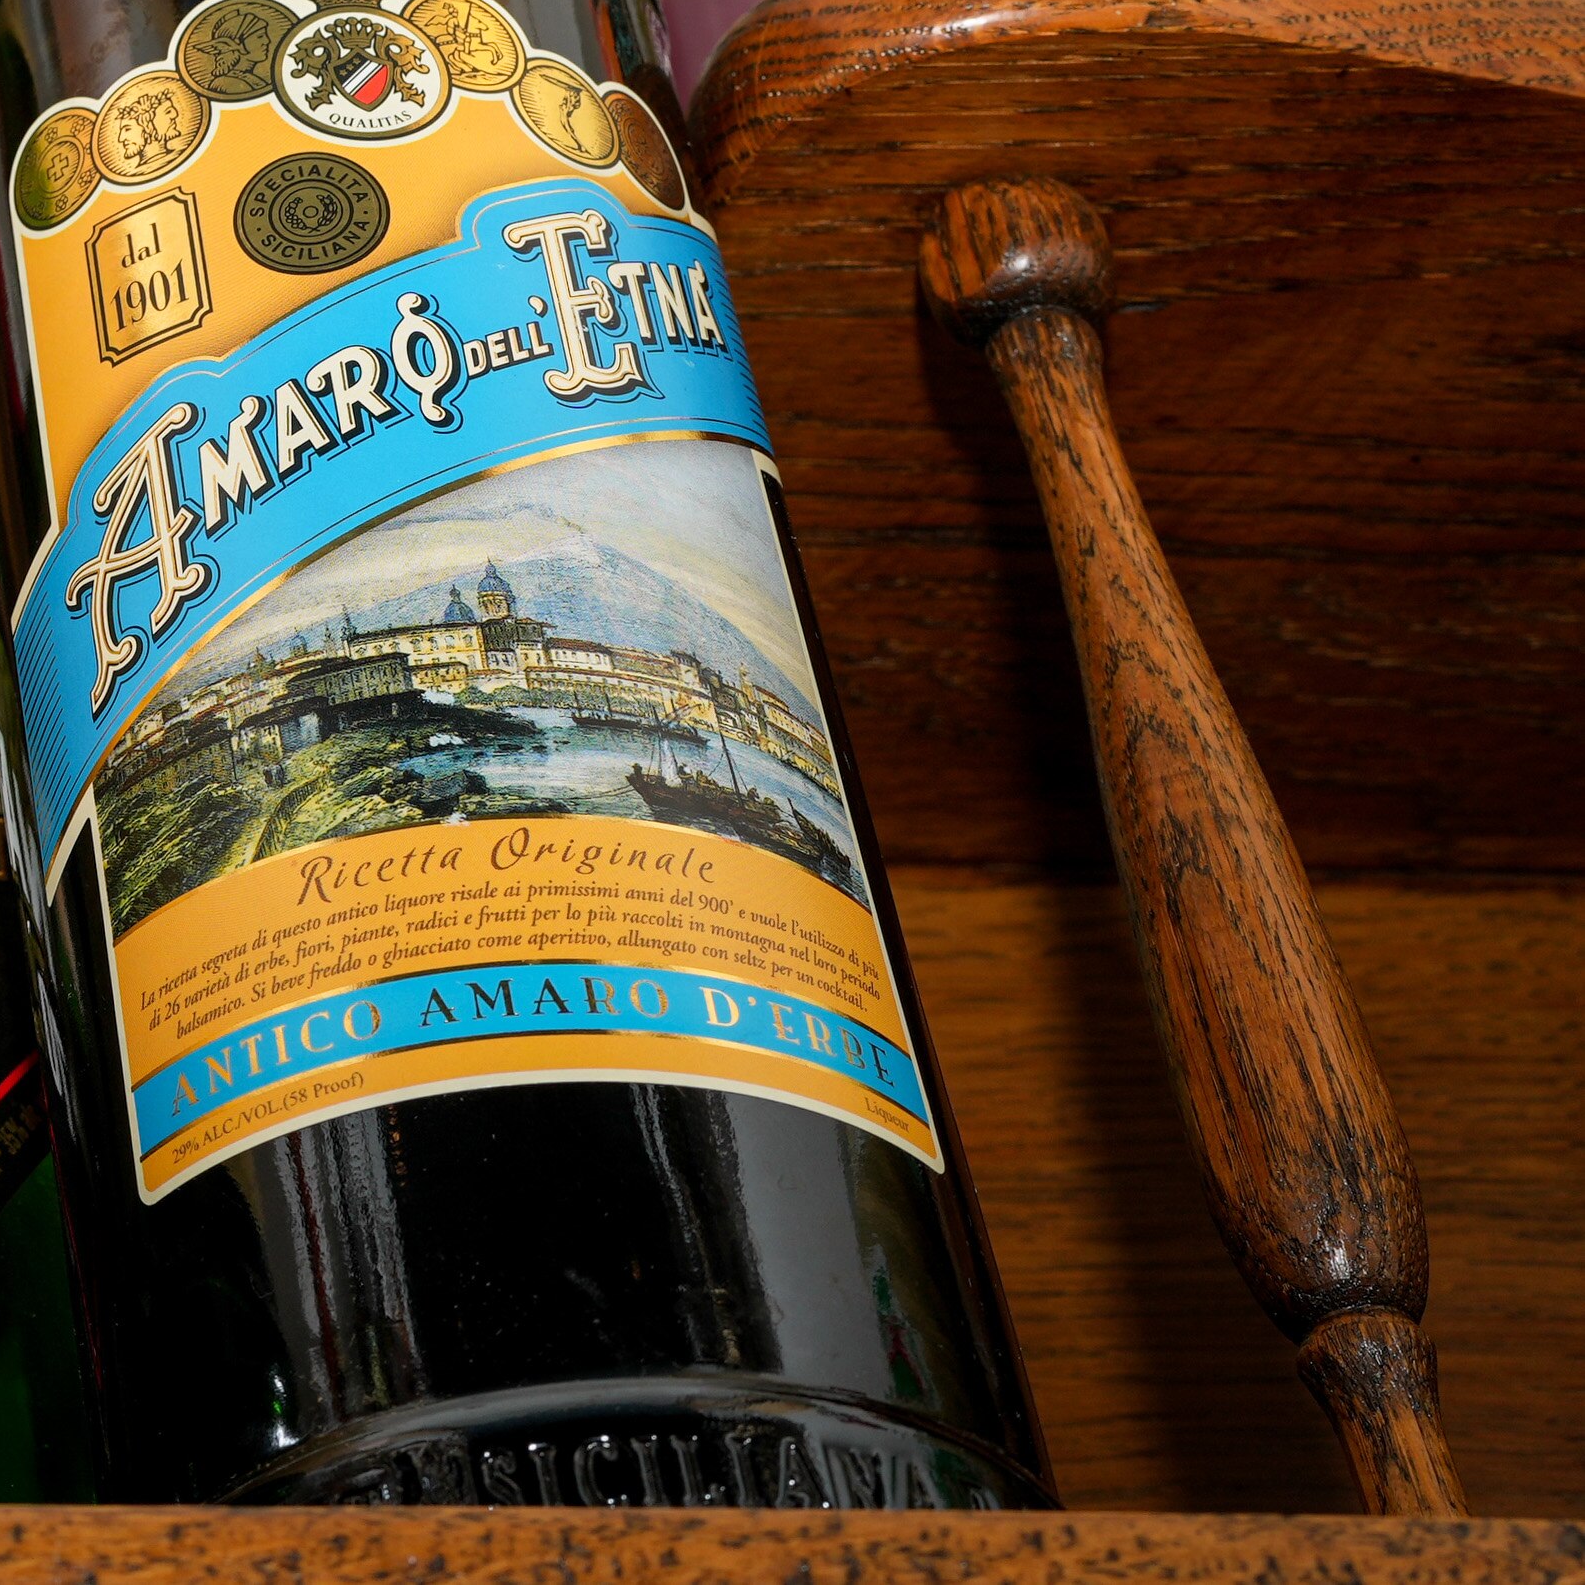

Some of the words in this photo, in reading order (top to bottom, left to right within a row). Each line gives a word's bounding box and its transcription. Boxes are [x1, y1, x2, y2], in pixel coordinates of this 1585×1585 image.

[329, 110, 413, 129] QUALITAS
[121, 222, 163, 269] dal
[261, 219, 370, 261] SICILIANA
[109, 258, 190, 332] 1901
[296, 844, 463, 907] Ricetta
[490, 826, 717, 884] Originale
[140, 991, 156, 1011] La
[156, 965, 198, 1002] ricetta
[200, 942, 248, 982] segreta
[251, 929, 269, 953] di
[271, 915, 322, 950] questo
[325, 900, 380, 927] antico
[383, 889, 446, 918] liquore
[450, 880, 499, 903] risale
[502, 881, 521, 899] ai
[527, 879, 621, 904] primissimi
[625, 885, 665, 904] anni
[669, 886, 695, 909] del
[697, 893, 734, 917] 900'
[737, 907, 747, 920] e
[749, 909, 788, 934] vuole
[790, 917, 846, 958] l'utilizzo
[847, 947, 861, 966] di
[861, 956, 880, 982] più
[147, 1008, 163, 1032] di
[163, 999, 181, 1022] 26
[182, 972, 231, 1013] varietà
[234, 962, 251, 985] di
[253, 948, 291, 976] erbe,
[293, 937, 336, 971] fiori,
[339, 920, 401, 953] piante,
[404, 913, 459, 936] radici
[462, 912, 473, 925] e
[474, 901, 527, 930] frutti
[530, 905, 561, 926] per
[565, 901, 582, 922] lo
[586, 903, 618, 929] più
[621, 905, 684, 929] raccolti
[688, 914, 706, 934] in
[710, 922, 787, 958] montagna
[788, 939, 811, 964] nel
[812, 947, 838, 975] loro
[839, 966, 882, 1002] periodo
[175, 995, 246, 1041] balsamico.
[249, 979, 267, 1002] Si
[270, 970, 306, 995] beve
[306, 955, 363, 990] freddo
[367, 954, 378, 967] o
[381, 936, 472, 971] ghiacciato
[476, 932, 523, 950] come
[526, 928, 612, 951] aperitivo,
[616, 930, 697, 958] allungato
[701, 942, 729, 961] con
[732, 947, 767, 972] seltz
[769, 960, 793, 982] per
[795, 969, 815, 988] un
[816, 975, 869, 1015] cocktail.
[170, 1000, 383, 1117] ANTICO
[417, 975, 670, 1029] AMARO
[698, 984, 896, 1089] D'ERBE
[171, 1136, 200, 1165] 29%
[312, 1071, 364, 1099] Proof)
[864, 1096, 911, 1134] Liqueur
